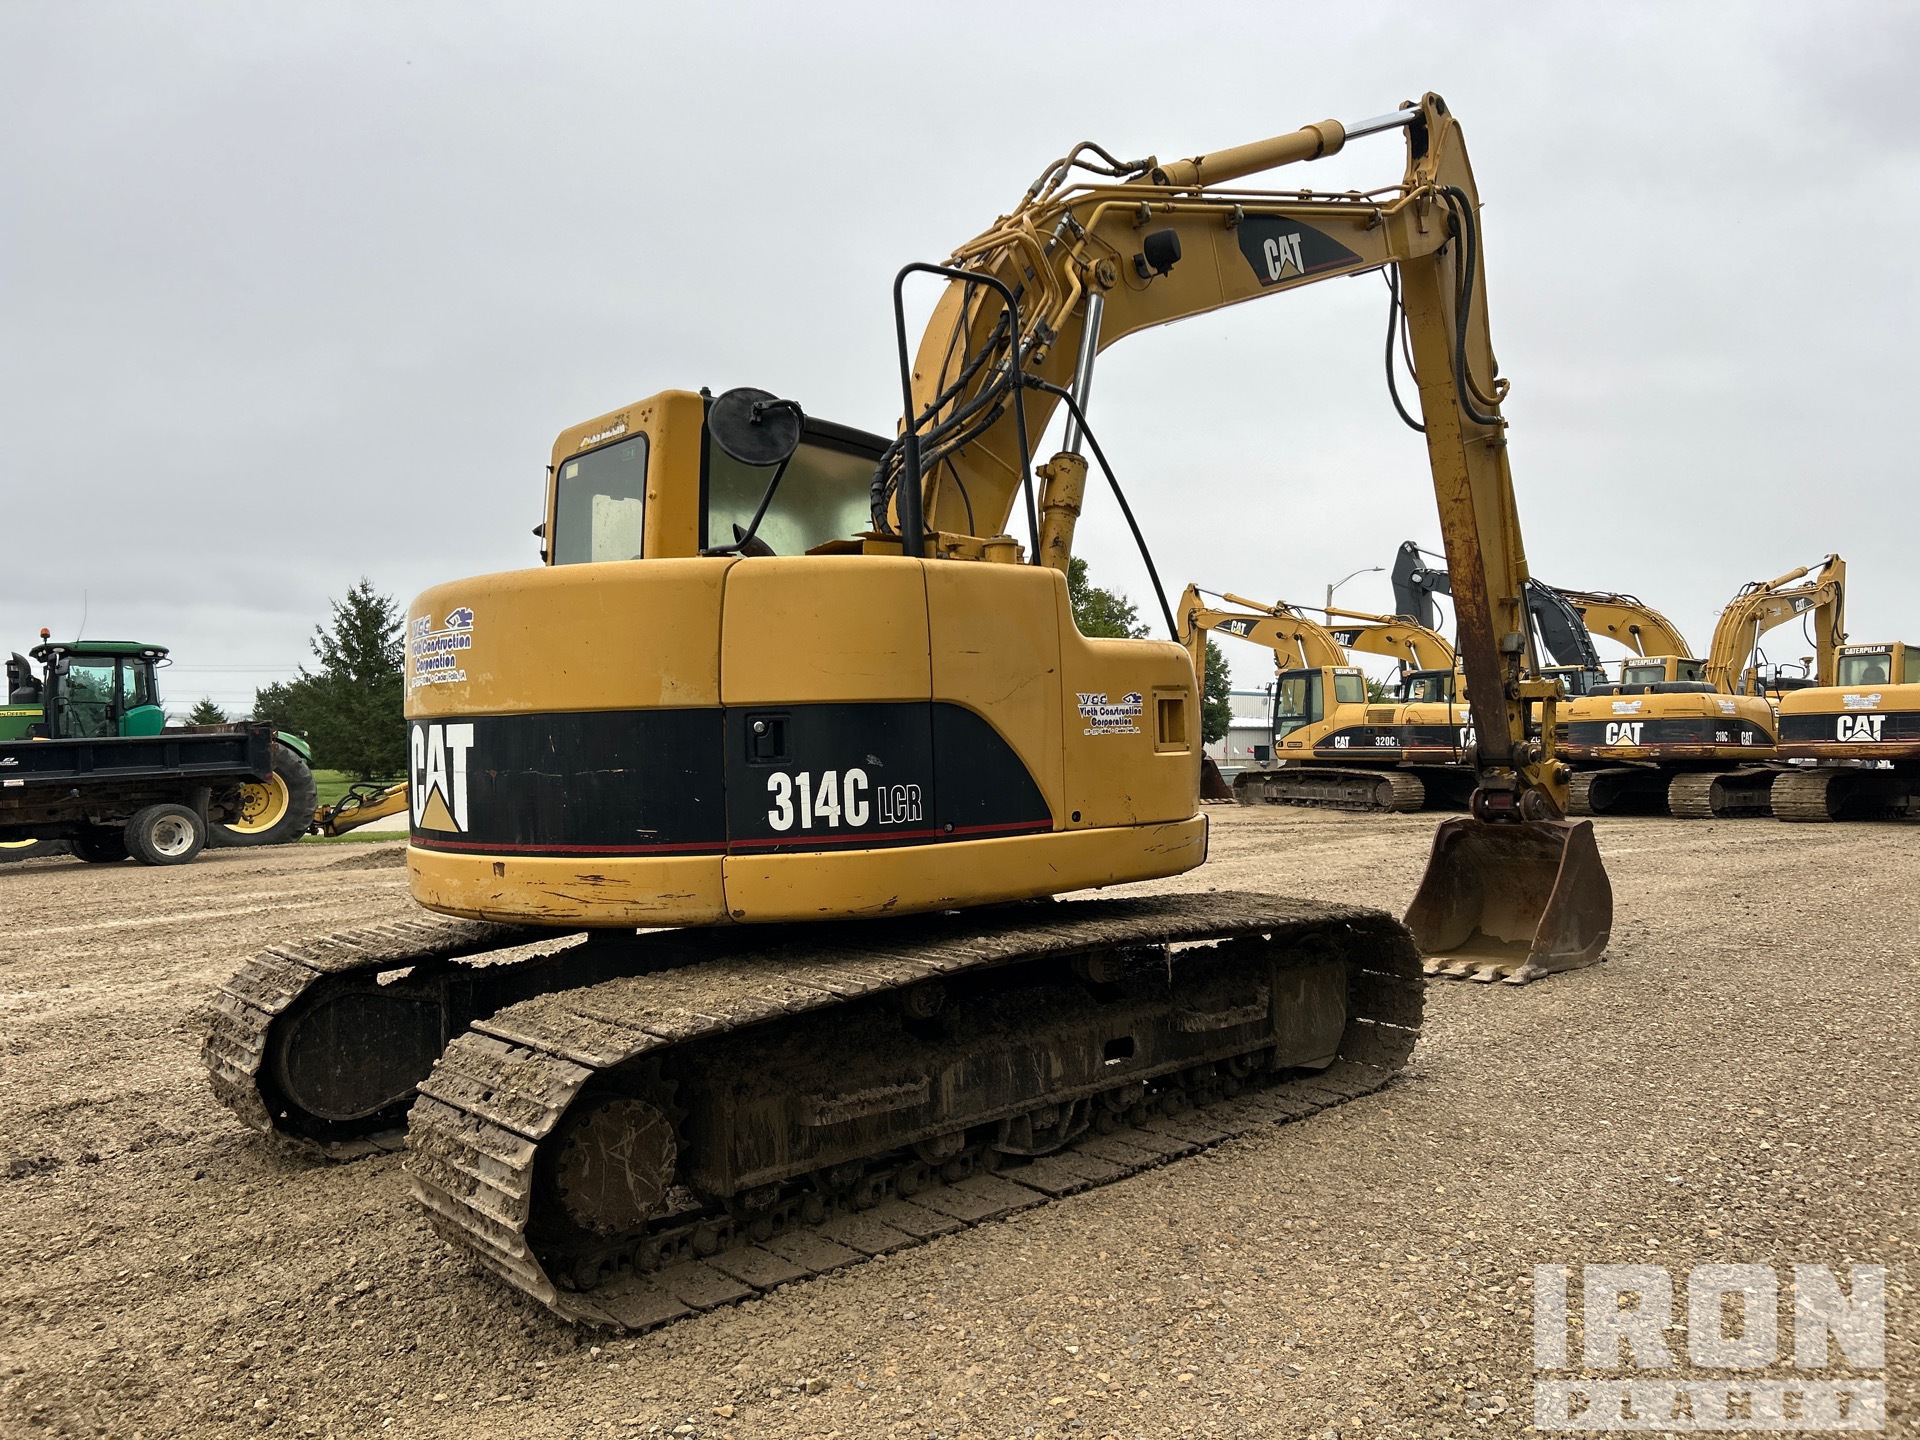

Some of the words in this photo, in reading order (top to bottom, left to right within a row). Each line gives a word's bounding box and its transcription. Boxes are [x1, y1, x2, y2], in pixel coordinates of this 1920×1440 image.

[1263, 232, 1305, 281] CAT
[1231, 620, 1247, 636] CAT
[422, 633, 470, 653] Construction
[1333, 632, 1350, 646] CAT
[1845, 645, 1886, 655] CATERPILLAR
[416, 654, 455, 672] Corporation
[1080, 706, 1098, 716] Vieth
[1100, 706, 1142, 716] Construction
[1091, 717, 1132, 727] Corporation
[1837, 715, 1886, 742] CAT
[1334, 736, 1350, 748] CAT
[1375, 736, 1396, 746] 320C
[1396, 738, 1401, 746] L
[1605, 722, 1644, 746] CAT
[1741, 731, 1753, 745] CAT
[411, 723, 474, 832] CAT
[767, 767, 869, 831] 314C
[877, 783, 923, 824] LCR
